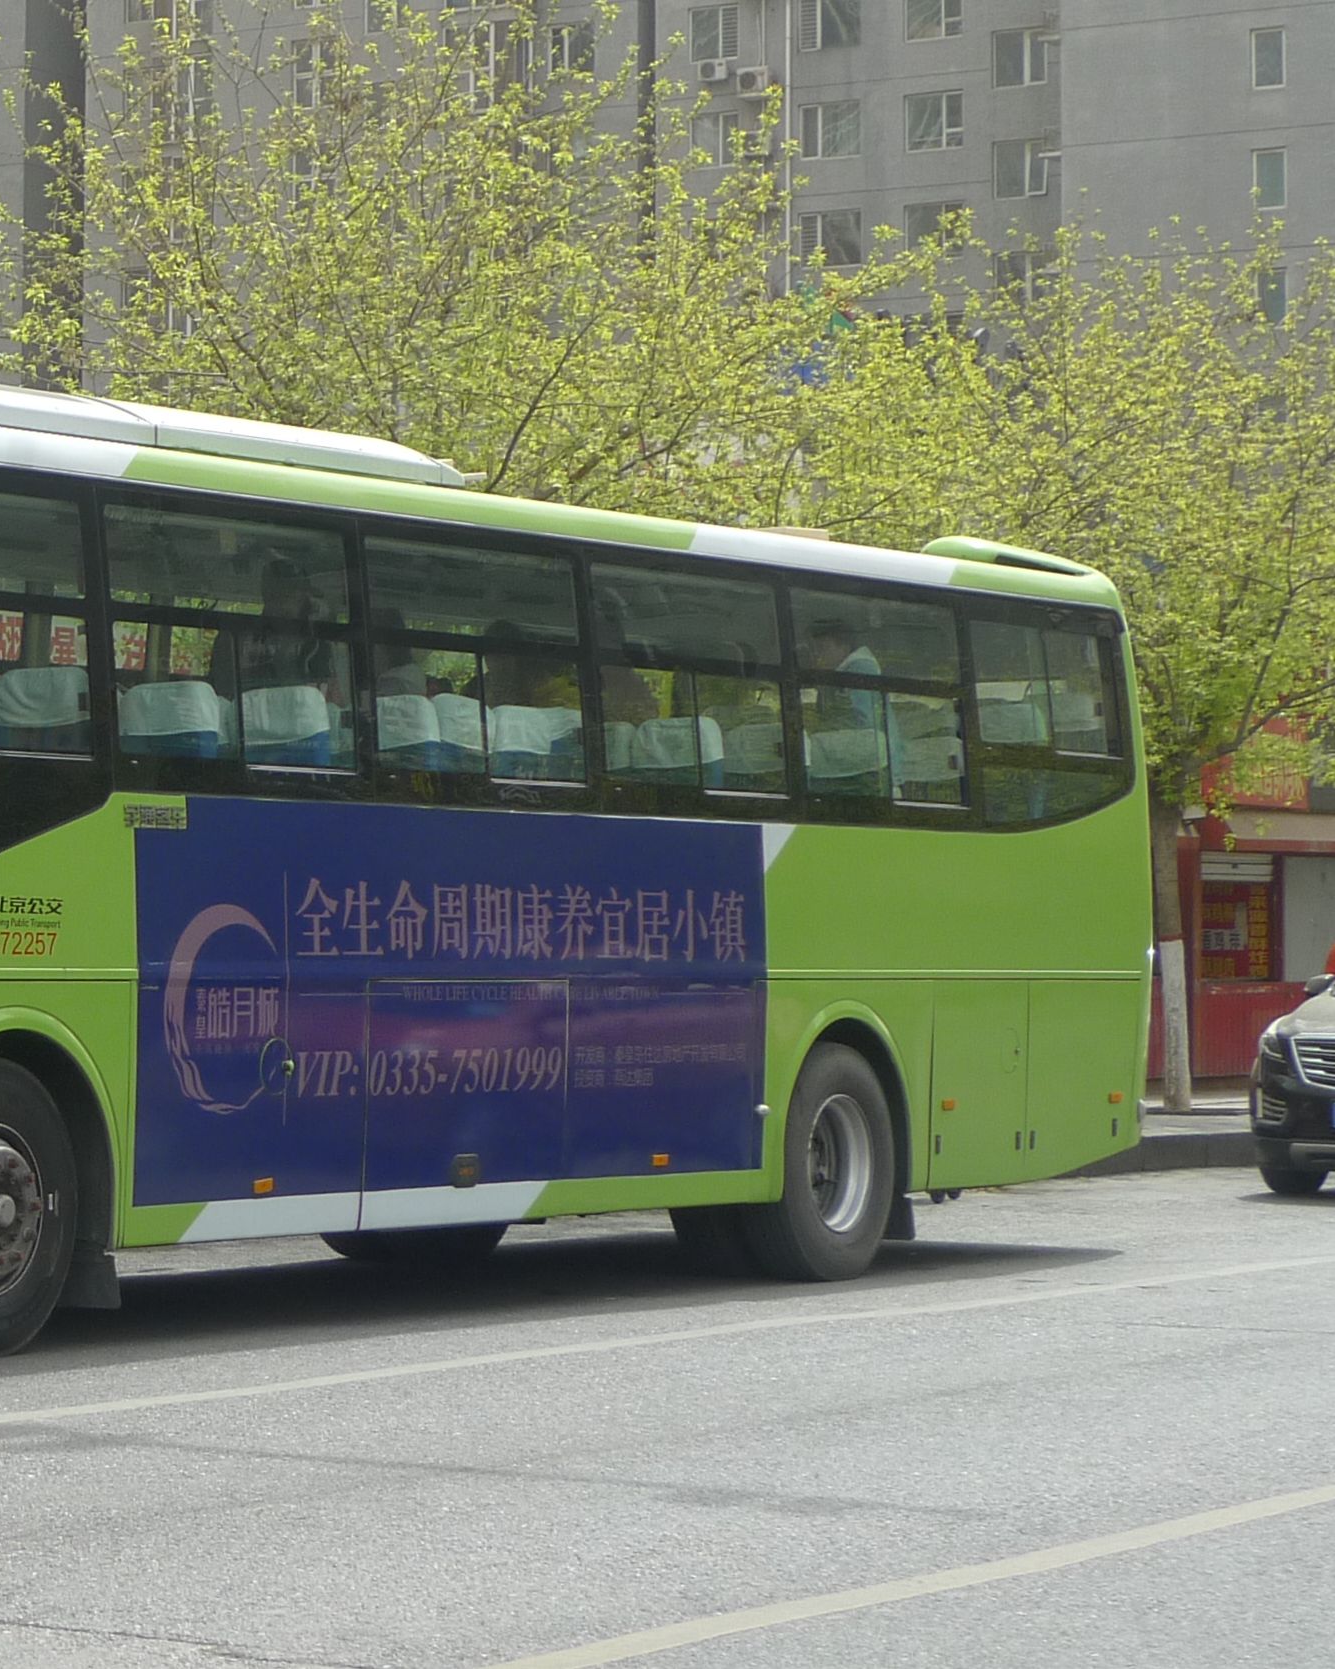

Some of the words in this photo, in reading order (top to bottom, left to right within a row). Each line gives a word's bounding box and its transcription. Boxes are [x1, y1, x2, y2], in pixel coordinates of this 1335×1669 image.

[11, 917, 29, 928] Public
[30, 918, 61, 929] Transport
[295, 877, 745, 962] 全生命周期康养宜居小镇
[296, 1051, 359, 1098] VIP:
[369, 1047, 562, 1097] 0335-7501999
